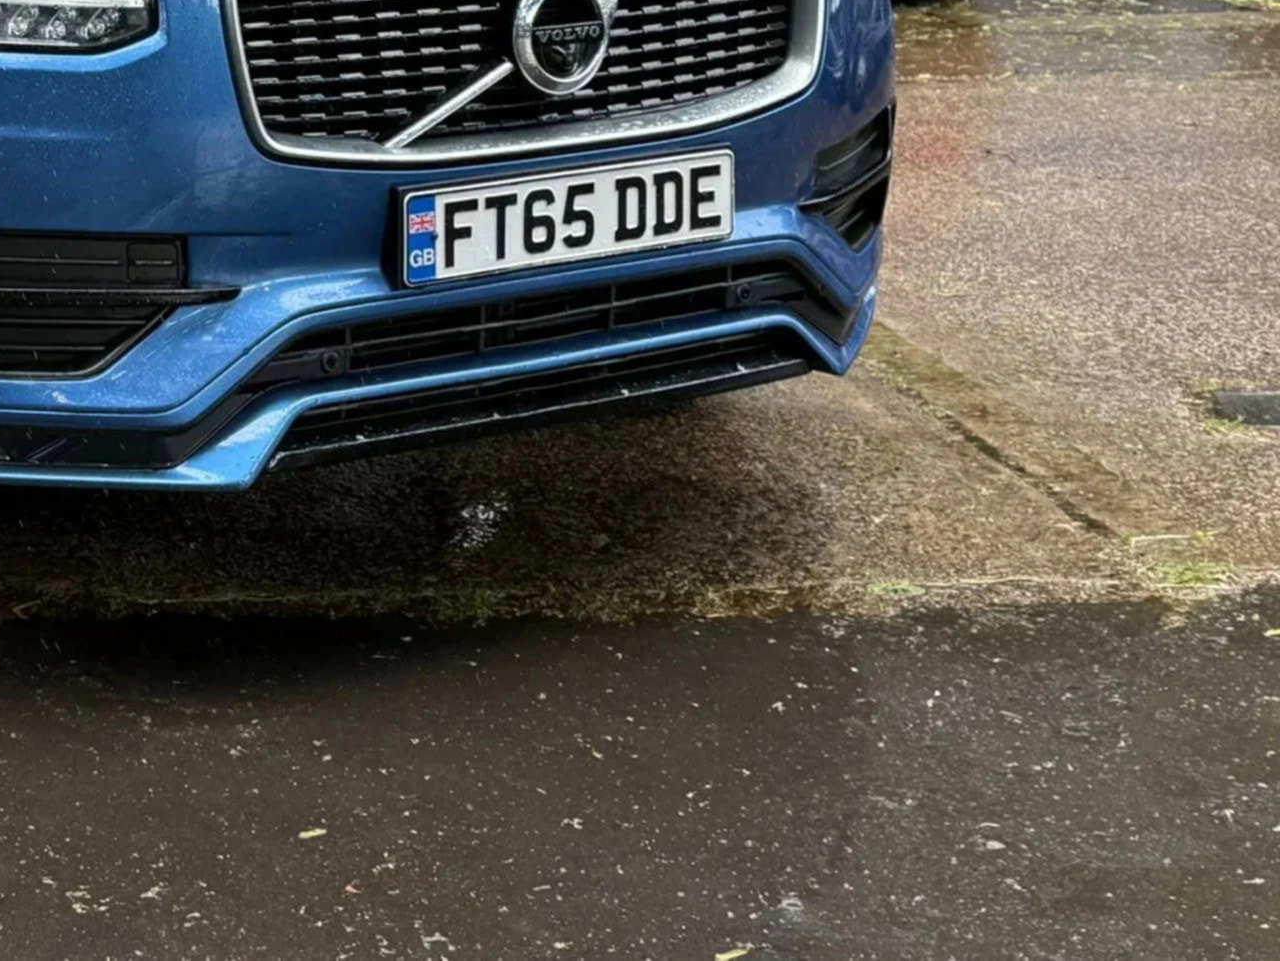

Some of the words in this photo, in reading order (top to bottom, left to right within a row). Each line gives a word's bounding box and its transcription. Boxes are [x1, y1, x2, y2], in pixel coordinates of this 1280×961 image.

[535, 25, 600, 43] VOLVO
[444, 183, 595, 269] FT65
[614, 164, 721, 242] DDE
[410, 250, 434, 268] GB
